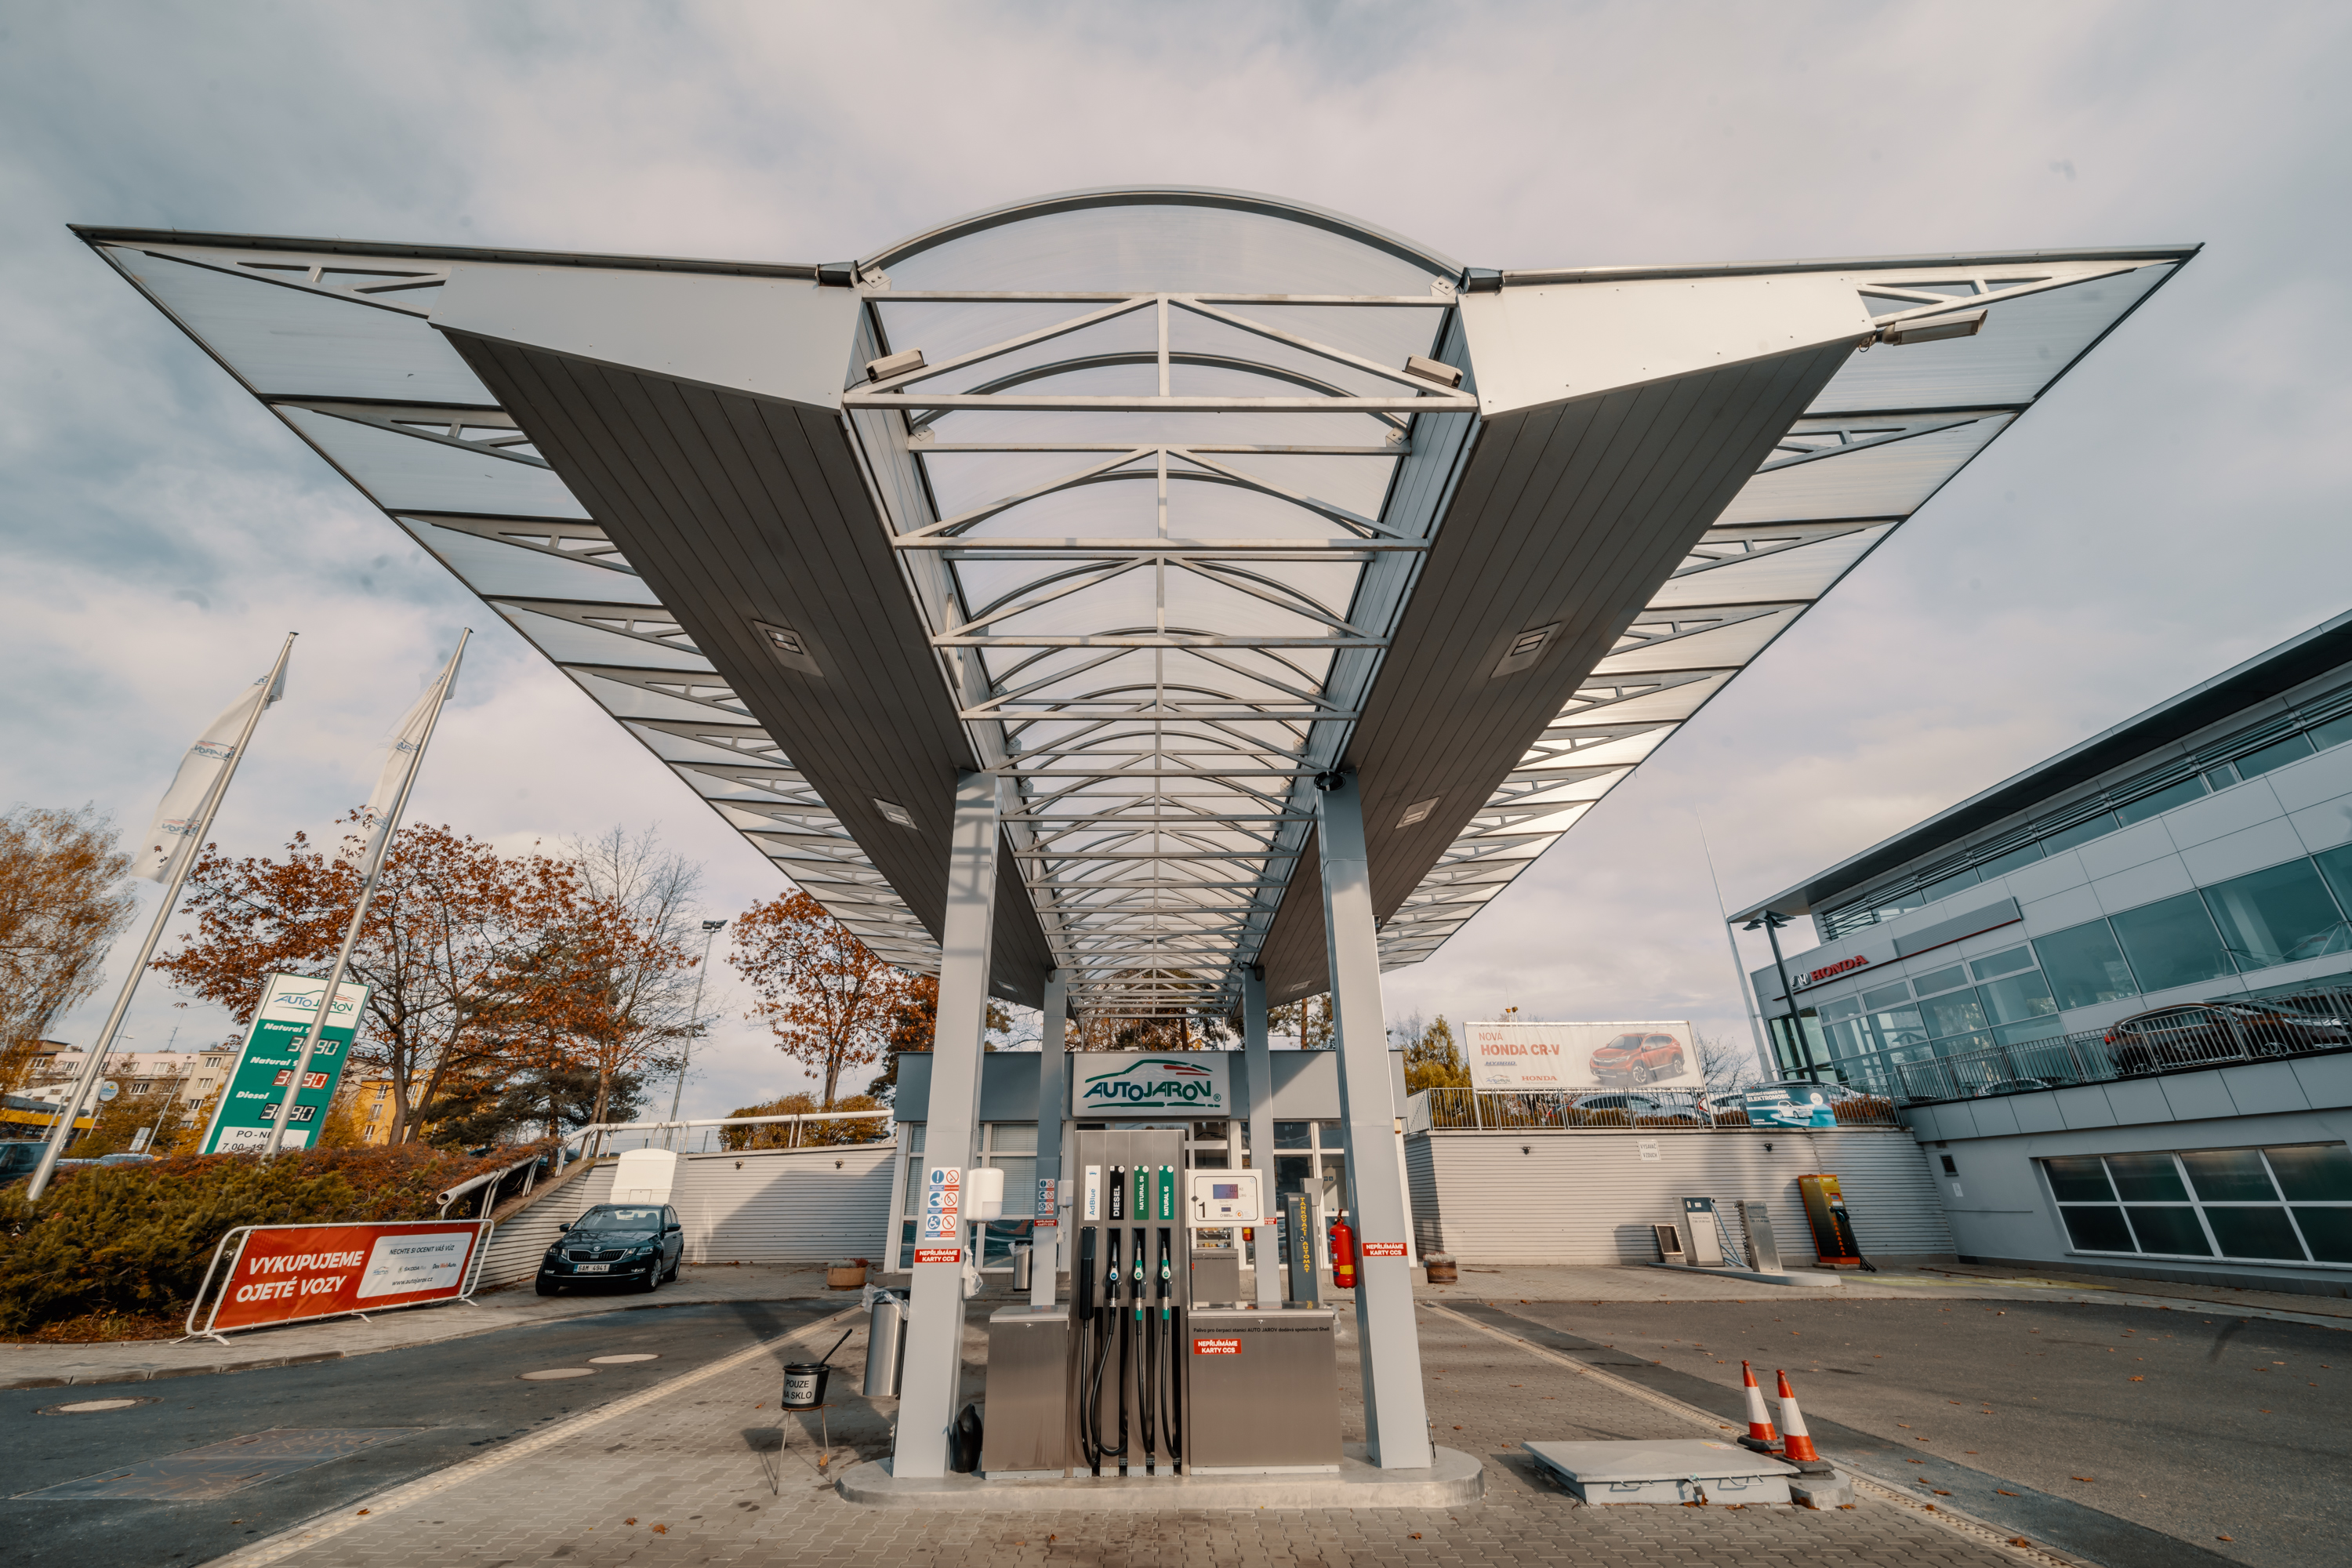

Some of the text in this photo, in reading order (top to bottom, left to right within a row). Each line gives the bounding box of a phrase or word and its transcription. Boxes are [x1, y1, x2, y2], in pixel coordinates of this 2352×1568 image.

[1809, 955, 1868, 982] HONDA
[263, 1022, 304, 1033] Natural
[1479, 1030, 1504, 1041] NOVÁ
[1480, 1044, 1560, 1055] HONDA CR-V
[250, 1056, 292, 1066] Natural
[236, 1091, 270, 1100] Diesel
[1747, 1093, 1791, 1102] ELEKTROMOBIL
[1199, 1202, 1206, 1218] 1
[249, 1250, 365, 1275] VYKUPUJEME
[392, 1277, 434, 1286] www.autojarov.cz
[236, 1276, 348, 1302] OJETÉ VOZY
[786, 1379, 810, 1388] POUZE
[790, 1391, 812, 1399] SKLO
